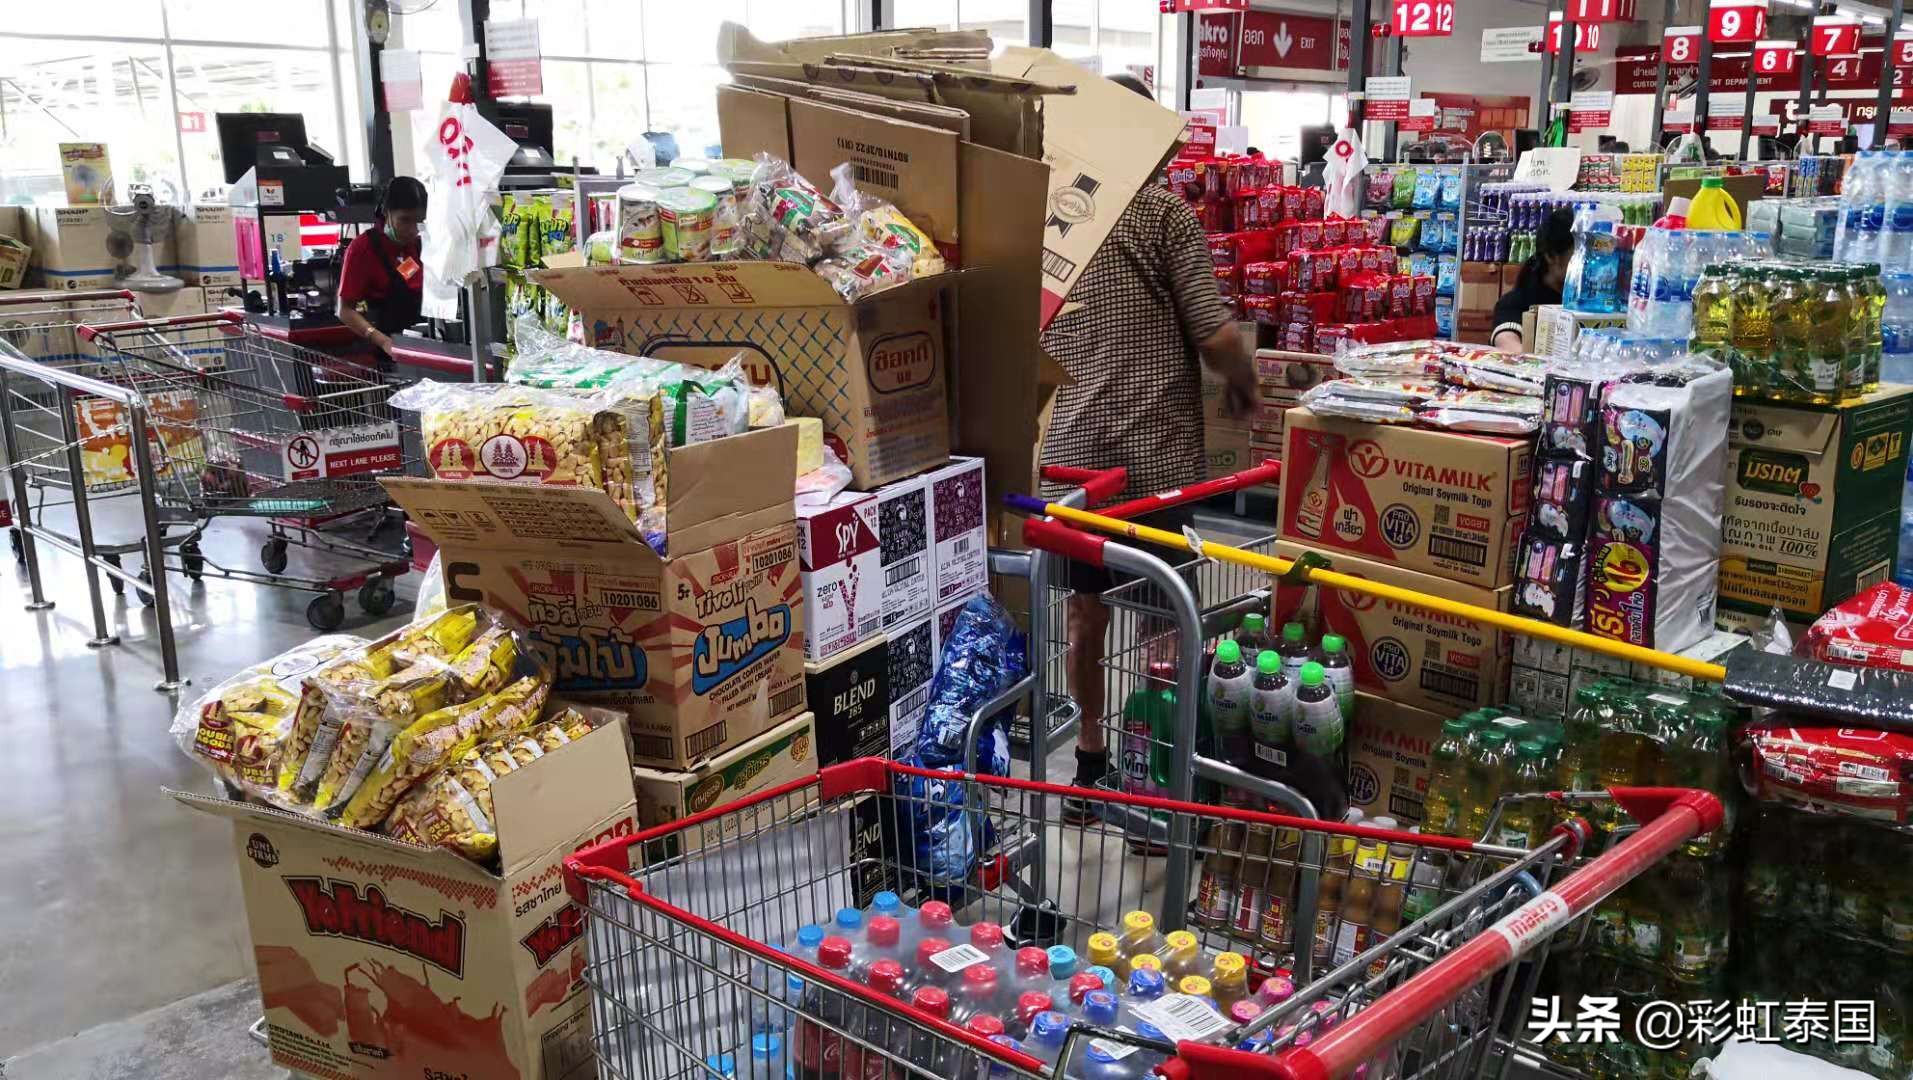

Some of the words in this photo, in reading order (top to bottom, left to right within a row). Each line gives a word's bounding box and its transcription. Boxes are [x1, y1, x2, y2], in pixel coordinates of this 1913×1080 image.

[1396, 3, 1432, 32] 12
[1435, 4, 1453, 31] 12
[1720, 10, 1741, 38] 9
[1754, 10, 1763, 36] 9
[1244, 29, 1264, 46] ออก
[1300, 37, 1316, 49] EXIT
[1587, 24, 1599, 49] 10
[1823, 28, 1842, 52] 7
[1671, 36, 1690, 61] 8
[1762, 50, 1777, 70] 6
[1831, 60, 1848, 77] 4
[1892, 68, 1904, 85] 2
[330, 460, 348, 469] NEXT
[350, 457, 368, 466] LANE
[370, 453, 397, 463] PLEASE
[1745, 461, 1802, 484] มรกต
[1394, 459, 1492, 492] VITAMILK
[1402, 482, 1434, 497] Original
[1436, 487, 1468, 503] Soymilk
[1472, 494, 1493, 509] Togo
[863, 504, 877, 519] PACK
[870, 516, 877, 528] 12
[1392, 510, 1409, 521] PRO
[835, 518, 860, 554] SPY
[1385, 516, 1416, 536] VITA
[754, 547, 793, 569] 10201086
[1779, 540, 1818, 558] 100%
[602, 591, 659, 609] 10201086
[695, 578, 745, 618] Tivoli
[816, 580, 838, 598] zero
[696, 596, 786, 678] Jumbo
[1392, 616, 1424, 632] Original
[1426, 623, 1459, 641] Soymilk
[1461, 632, 1482, 647] Togo
[1375, 648, 1406, 670] VITA
[1383, 643, 1400, 655] PRO
[709, 676, 741, 701] CHOCOLATE
[742, 662, 763, 680] COATED
[721, 689, 740, 704] FILLED
[740, 680, 754, 692] WITH
[833, 678, 876, 716] BLEND
[250, 839, 271, 853] UNI
[515, 881, 562, 918] รสชาไทย
